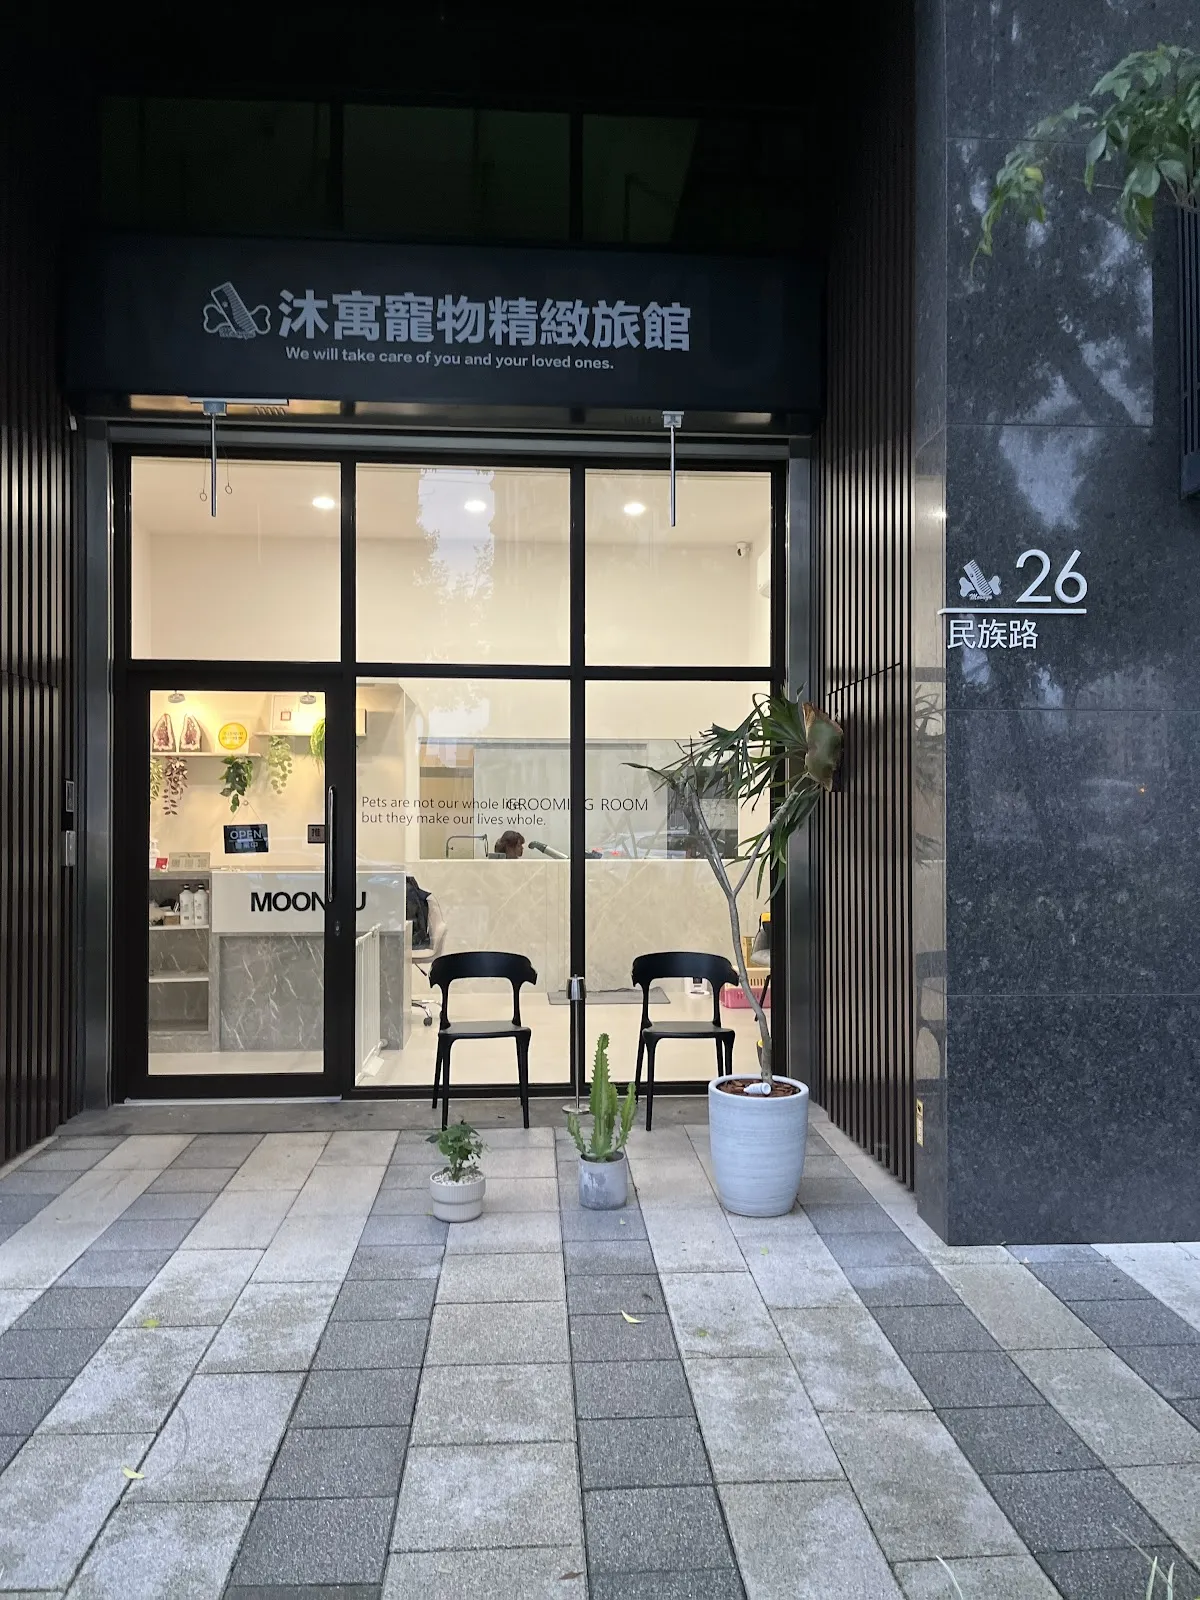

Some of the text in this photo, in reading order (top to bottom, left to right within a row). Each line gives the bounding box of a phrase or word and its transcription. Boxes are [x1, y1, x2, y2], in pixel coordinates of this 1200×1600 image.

[278, 289, 691, 352] 沐寓寵物精緻旅館
[286, 346, 614, 369] We will take care of you and your loved ones.
[1015, 549, 1088, 604] 26
[947, 619, 1038, 649] 民族路
[362, 796, 387, 808] Pets
[390, 799, 410, 809] are
[413, 797, 435, 809] not
[438, 800, 458, 810] our
[462, 798, 499, 809] whole
[507, 798, 648, 811] GROOMIG ROOM
[362, 812, 546, 826] but they make our lives whole.
[230, 829, 262, 840] OPEN
[251, 891, 366, 911] MOONU
